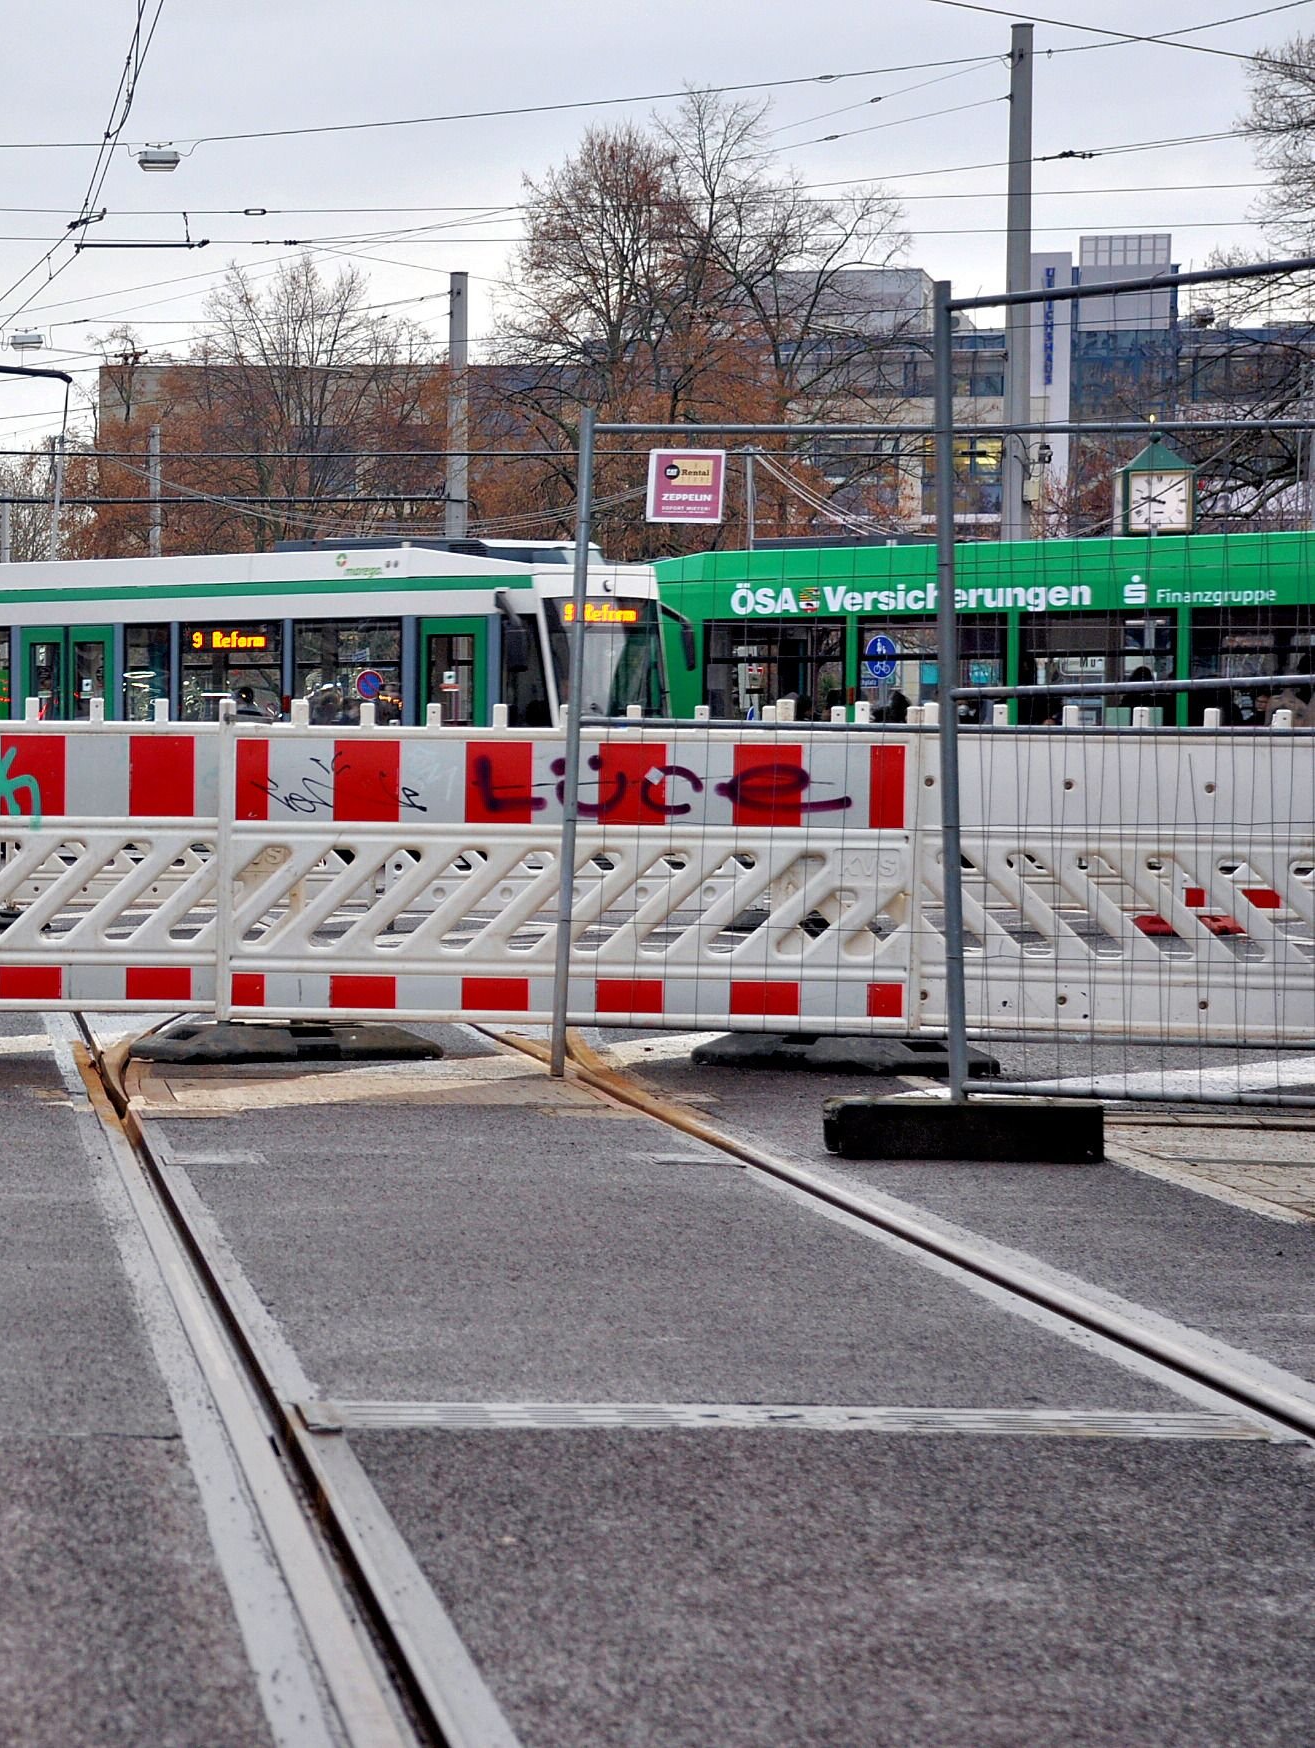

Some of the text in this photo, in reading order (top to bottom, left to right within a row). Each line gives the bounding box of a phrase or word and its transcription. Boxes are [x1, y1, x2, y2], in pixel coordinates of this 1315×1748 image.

[681, 468, 710, 476] Rental
[661, 493, 712, 502] ZEPPELIN
[730, 583, 799, 615] ÖSA
[1156, 586, 1278, 607] Finanzgruppe
[583, 603, 638, 622] Reform
[192, 630, 266, 648] 9 Reform
[837, 857, 898, 877] KVS
